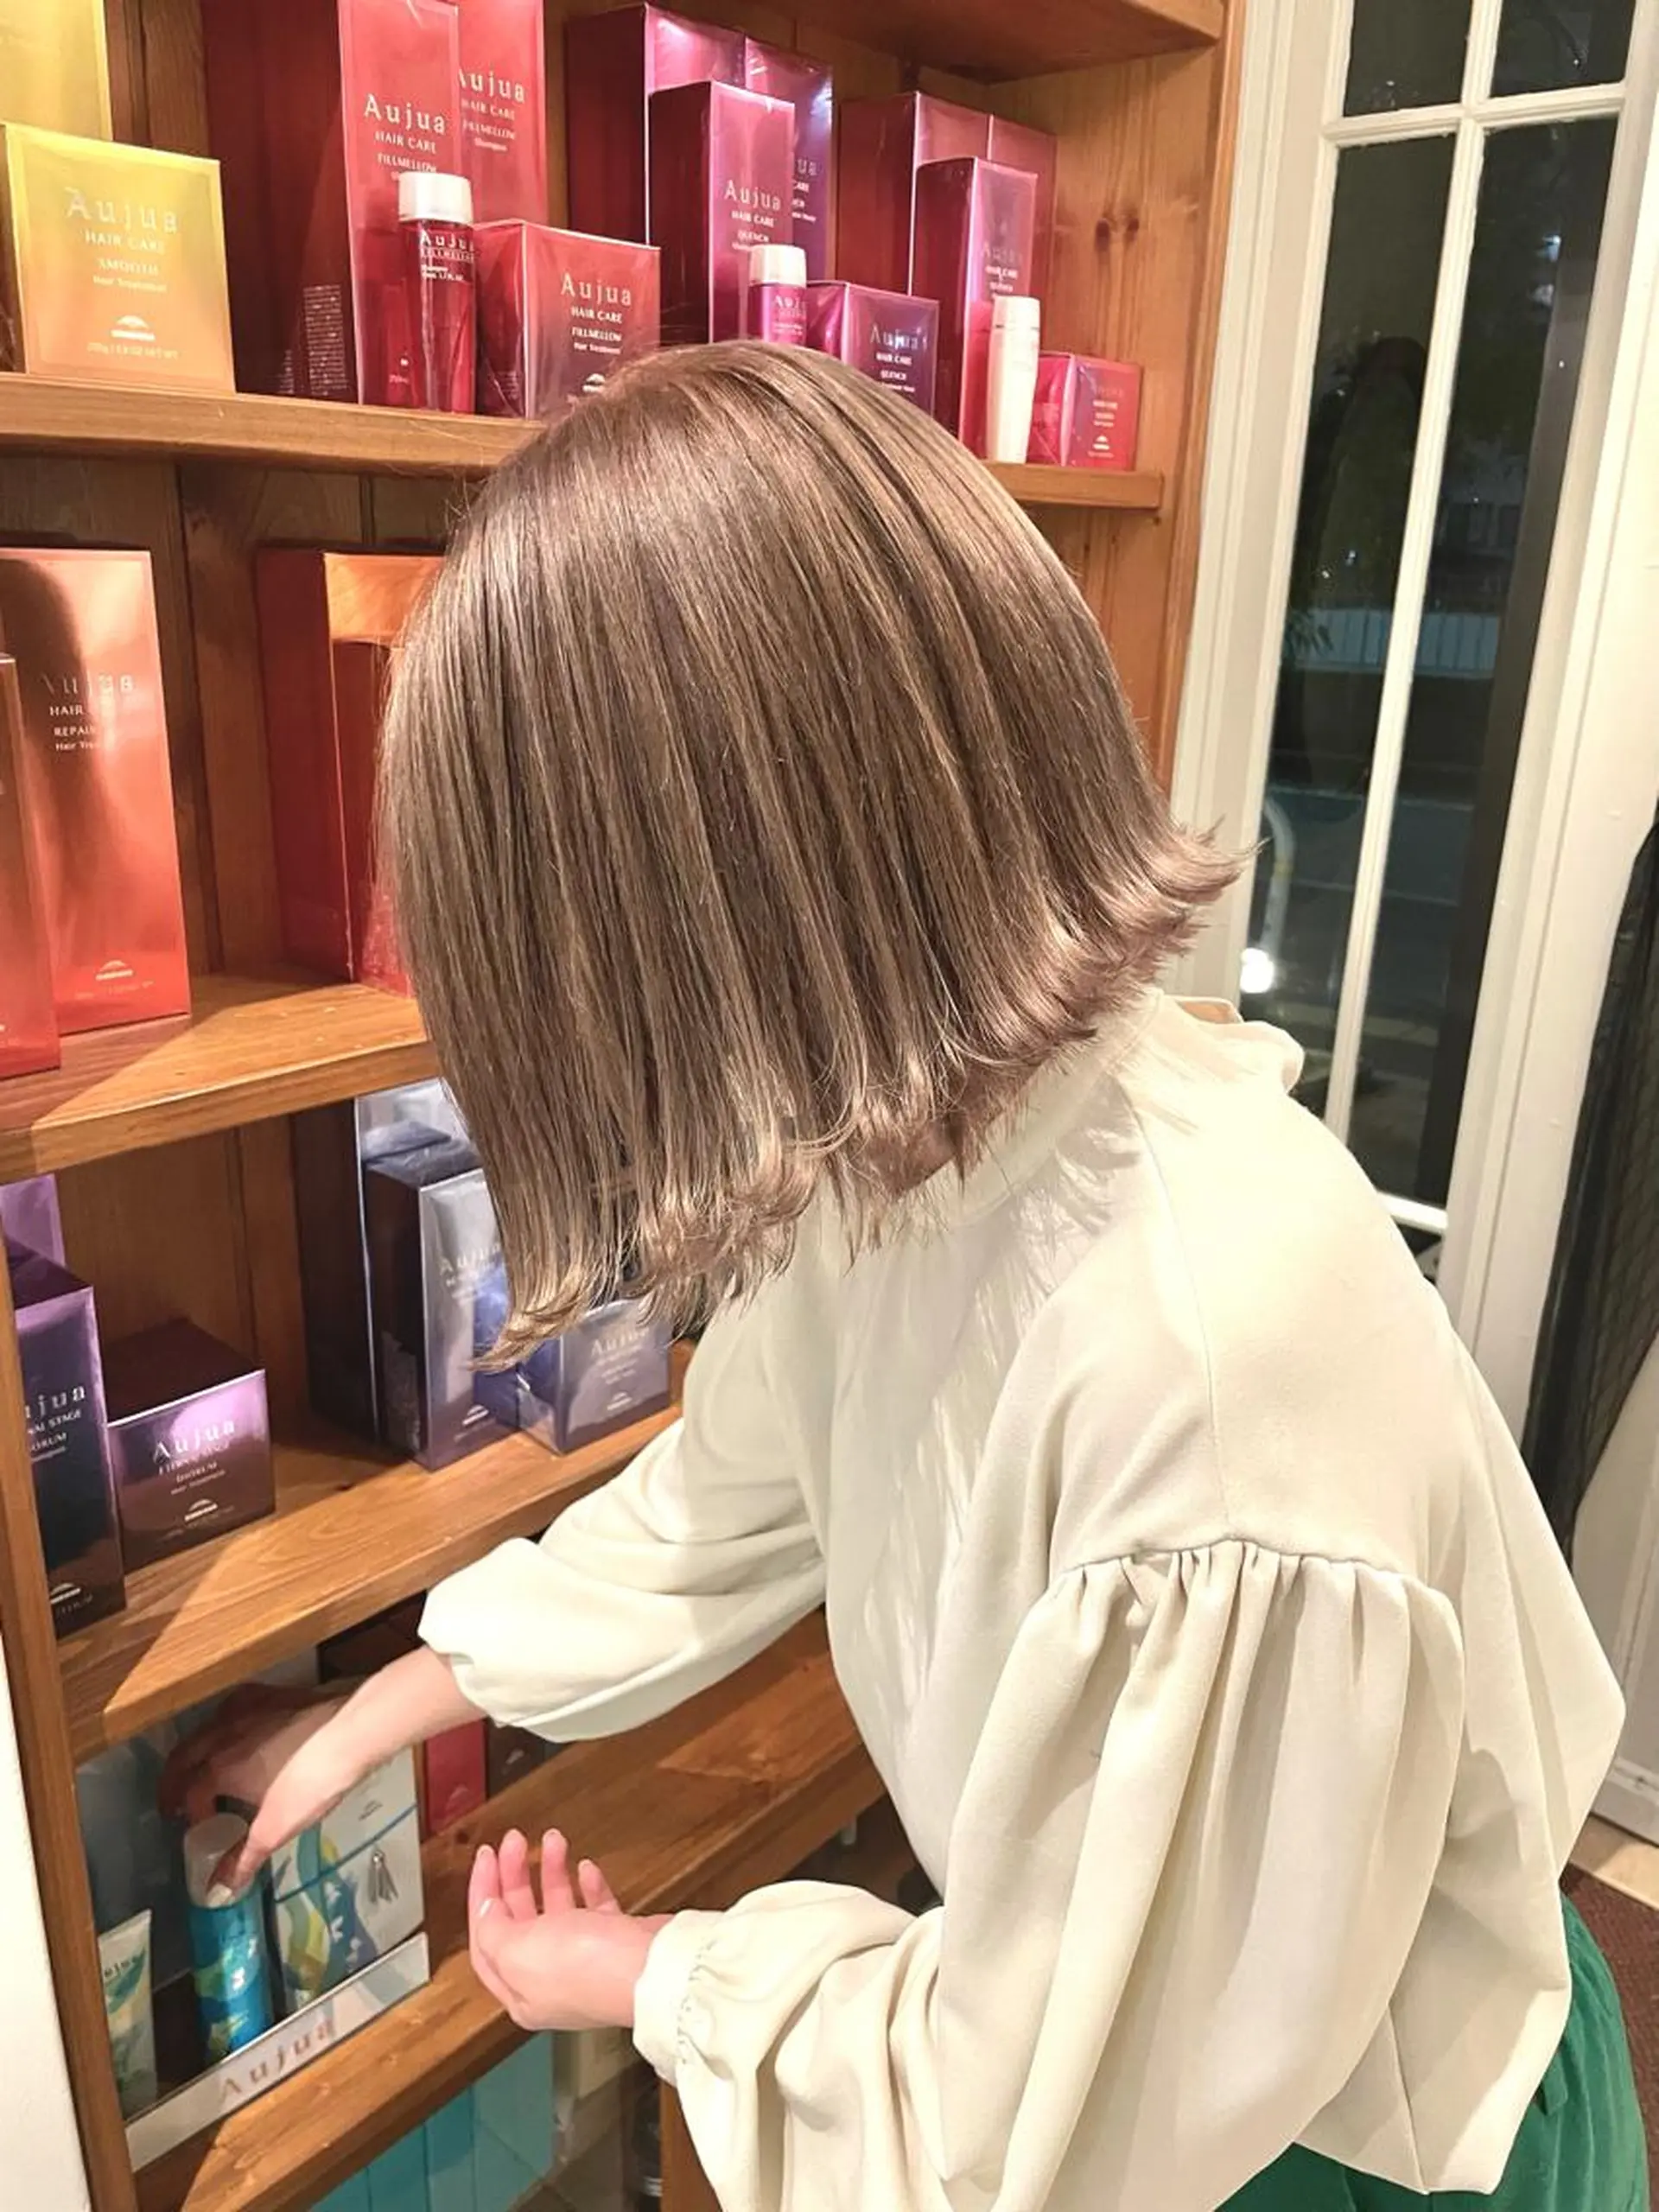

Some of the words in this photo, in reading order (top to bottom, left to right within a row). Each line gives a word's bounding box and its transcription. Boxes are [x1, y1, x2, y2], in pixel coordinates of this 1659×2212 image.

[364, 93, 446, 136] Aujua
[461, 98, 487, 114] HAIR
[490, 105, 516, 121] CARE
[374, 130, 404, 148] HAIR
[407, 137, 437, 155] CARE
[724, 178, 781, 212] Aujua
[64, 186, 179, 234] Aujua
[730, 210, 752, 223] HAIR
[753, 213, 775, 228] CARE
[85, 228, 123, 247] HAIR
[126, 236, 166, 255] CARE
[98, 257, 160, 277] SMOOTH
[560, 272, 632, 307] Aujua
[570, 306, 596, 320] HAIR
[596, 310, 623, 325] CARE
[49, 704, 84, 716] HAIR
[55, 742, 77, 752] Hair
[31, 1431, 67, 1451] ORUM
[152, 1420, 236, 1466] Aujua
[219, 2017, 335, 2106] Aujua
